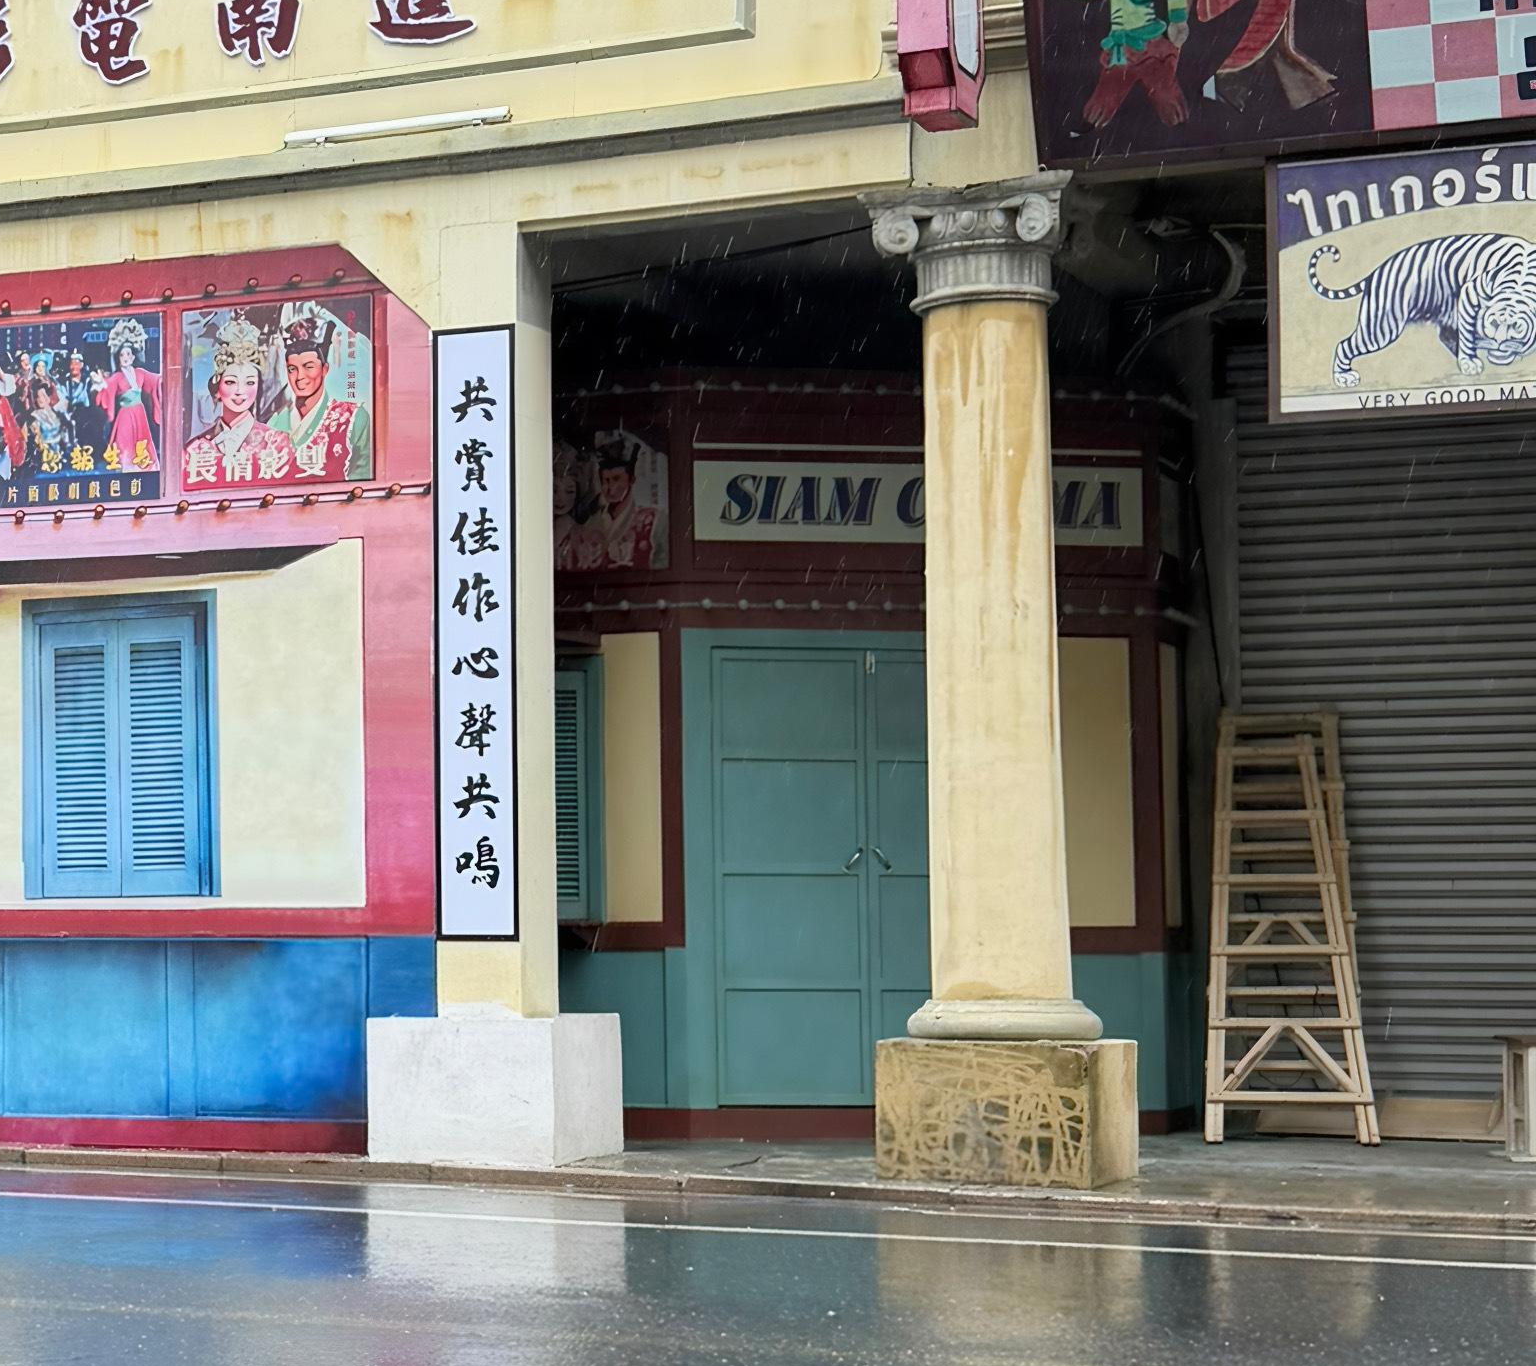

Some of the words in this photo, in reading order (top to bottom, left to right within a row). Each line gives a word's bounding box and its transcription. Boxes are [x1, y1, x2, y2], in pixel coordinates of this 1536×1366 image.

[1357, 392, 1411, 410] VERY
[1425, 388, 1486, 406] GOOD
[1500, 384, 1536, 403] MA
[720, 473, 882, 526] SIAM
[450, 376, 501, 890] 共賞佳作心聲共鳴
